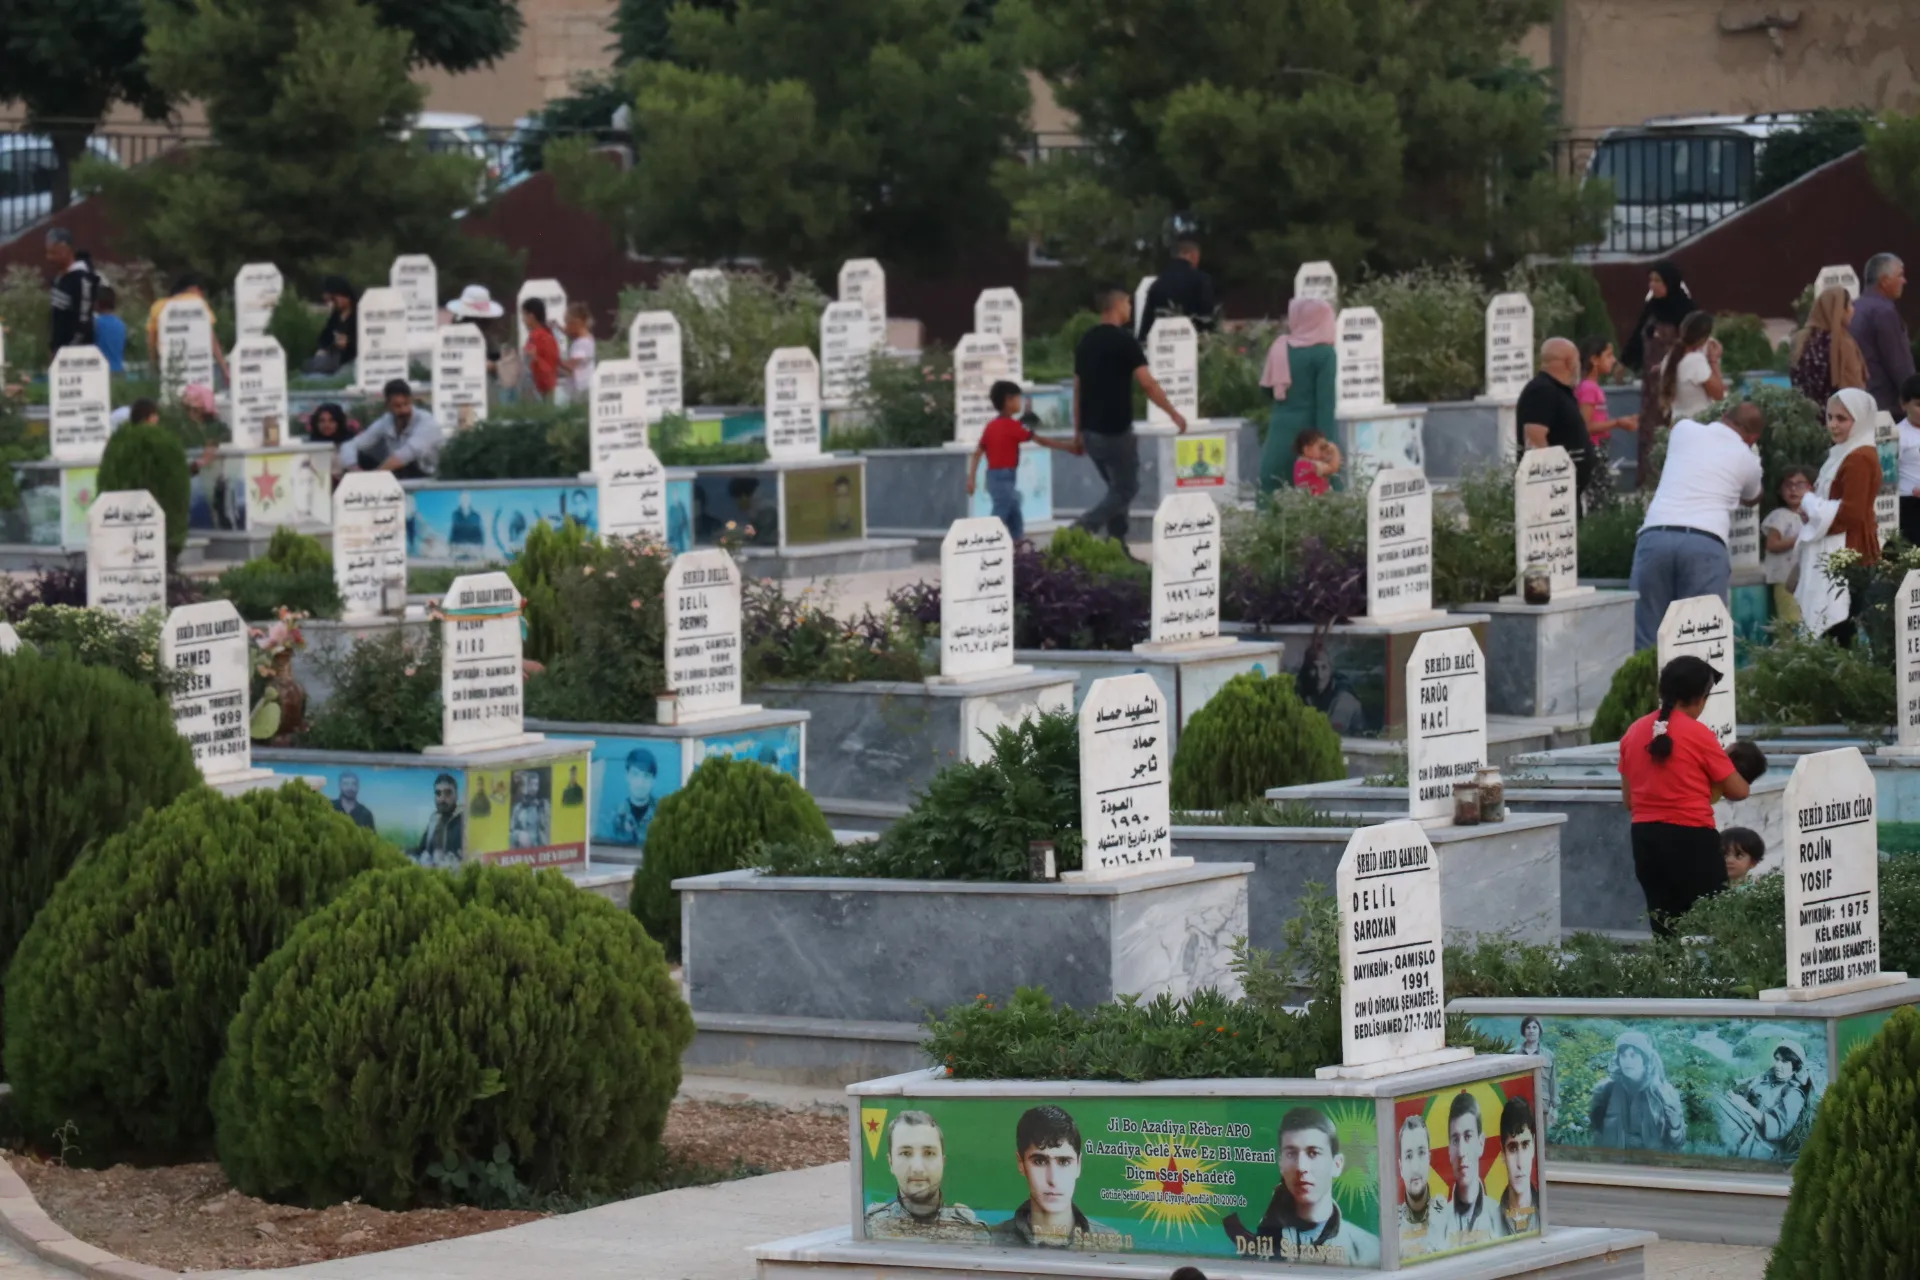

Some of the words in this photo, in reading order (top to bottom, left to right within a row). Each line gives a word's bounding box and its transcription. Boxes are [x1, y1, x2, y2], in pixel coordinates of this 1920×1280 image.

[1697, 615, 1723, 635] الشهيد
[176, 649, 210, 668] EHMED
[1421, 681, 1448, 704] FARÛQ
[212, 709, 241, 727] 1999
[1097, 705, 1122, 723] حماد
[1125, 695, 1157, 721] الشهيد
[1133, 736, 1156, 749] حماد
[1111, 814, 1149, 829] ١٩٩٠
[1798, 801, 1823, 828] ŞEHÎD
[1800, 836, 1832, 864] ROJÎN
[1357, 846, 1377, 876] ŞEHÎD
[1379, 849, 1397, 870] AMED
[1399, 846, 1428, 868] QAMIŞLO
[1800, 869, 1832, 892] YOSIF
[1353, 884, 1396, 912] DELÎL
[1841, 900, 1868, 918] 1975
[1354, 916, 1396, 942] SAROXAN
[1395, 950, 1435, 970] QAMIŞLO
[1801, 952, 1811, 967] CIH
[1401, 971, 1430, 990] 1991
[1802, 970, 1817, 987] BEYT
[1819, 965, 1844, 984] ELSEBAB
[1355, 1003, 1366, 1018] CIH
[1368, 997, 1373, 1016] Û
[1375, 995, 1399, 1014] DÎROKA
[1404, 1011, 1442, 1033] 27-7-2012
[1107, 1118, 1119, 1132] Ji
[1122, 1119, 1137, 1132] Bo
[1141, 1120, 1185, 1136] Azadiya
[1189, 1122, 1222, 1136] Rêber
[1226, 1123, 1251, 1138] APO
[1086, 1140, 1094, 1154] û
[1096, 1141, 1141, 1158] Azadiya
[1144, 1143, 1170, 1158] Gelê
[1174, 1145, 1197, 1158] Xwe
[1201, 1146, 1214, 1159] Ez
[1219, 1147, 1231, 1160] Bi
[1235, 1147, 1276, 1163] Mêranî
[1160, 1169, 1178, 1182] Ser
[1182, 1170, 1235, 1186] Şehadetê
